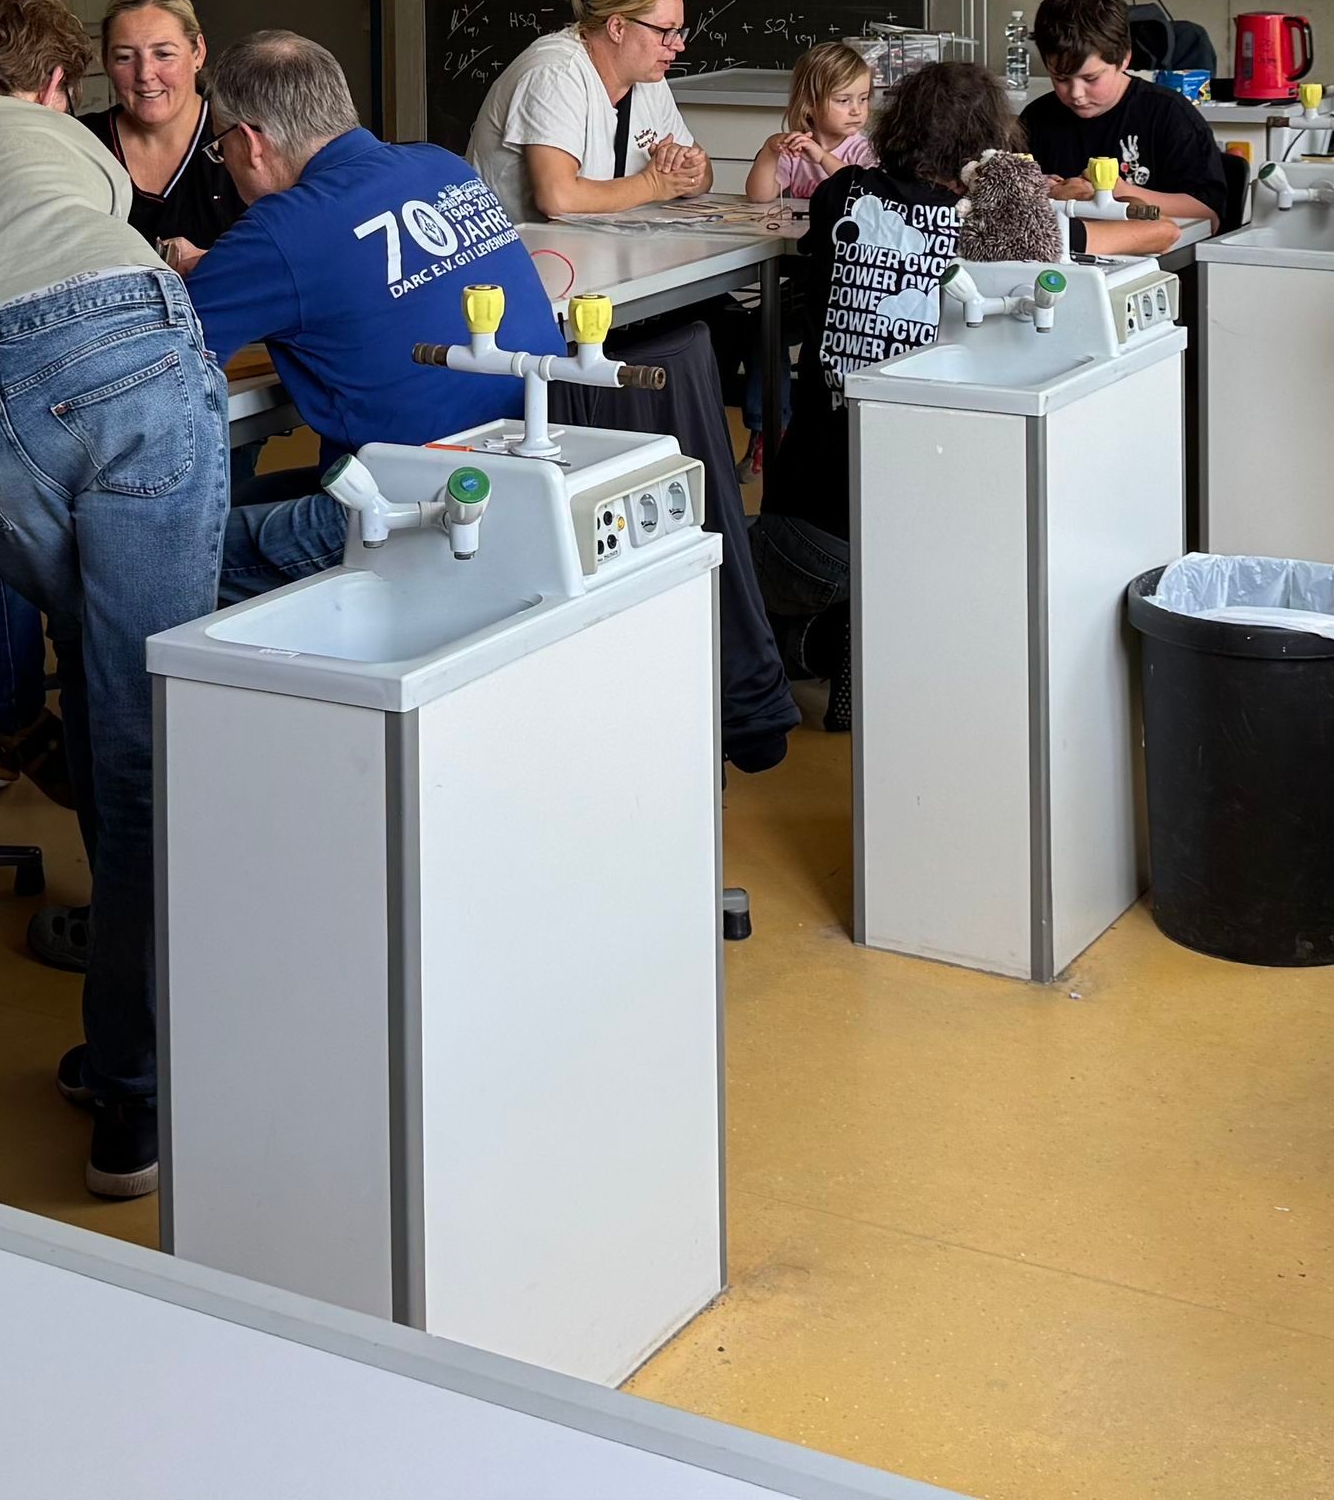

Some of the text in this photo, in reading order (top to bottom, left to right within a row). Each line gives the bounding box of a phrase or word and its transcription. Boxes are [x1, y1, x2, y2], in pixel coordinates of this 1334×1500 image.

[444, 192, 500, 224] 1949-2019
[353, 199, 459, 286] 70
[454, 206, 513, 248] JAHRE
[834, 240, 901, 270] POWER
[389, 268, 433, 300] DARC
[430, 258, 458, 278] E.V.
[456, 249, 478, 267] G11
[830, 261, 897, 292] POWER
[824, 306, 890, 339] POWER
[821, 329, 886, 361] POWER
